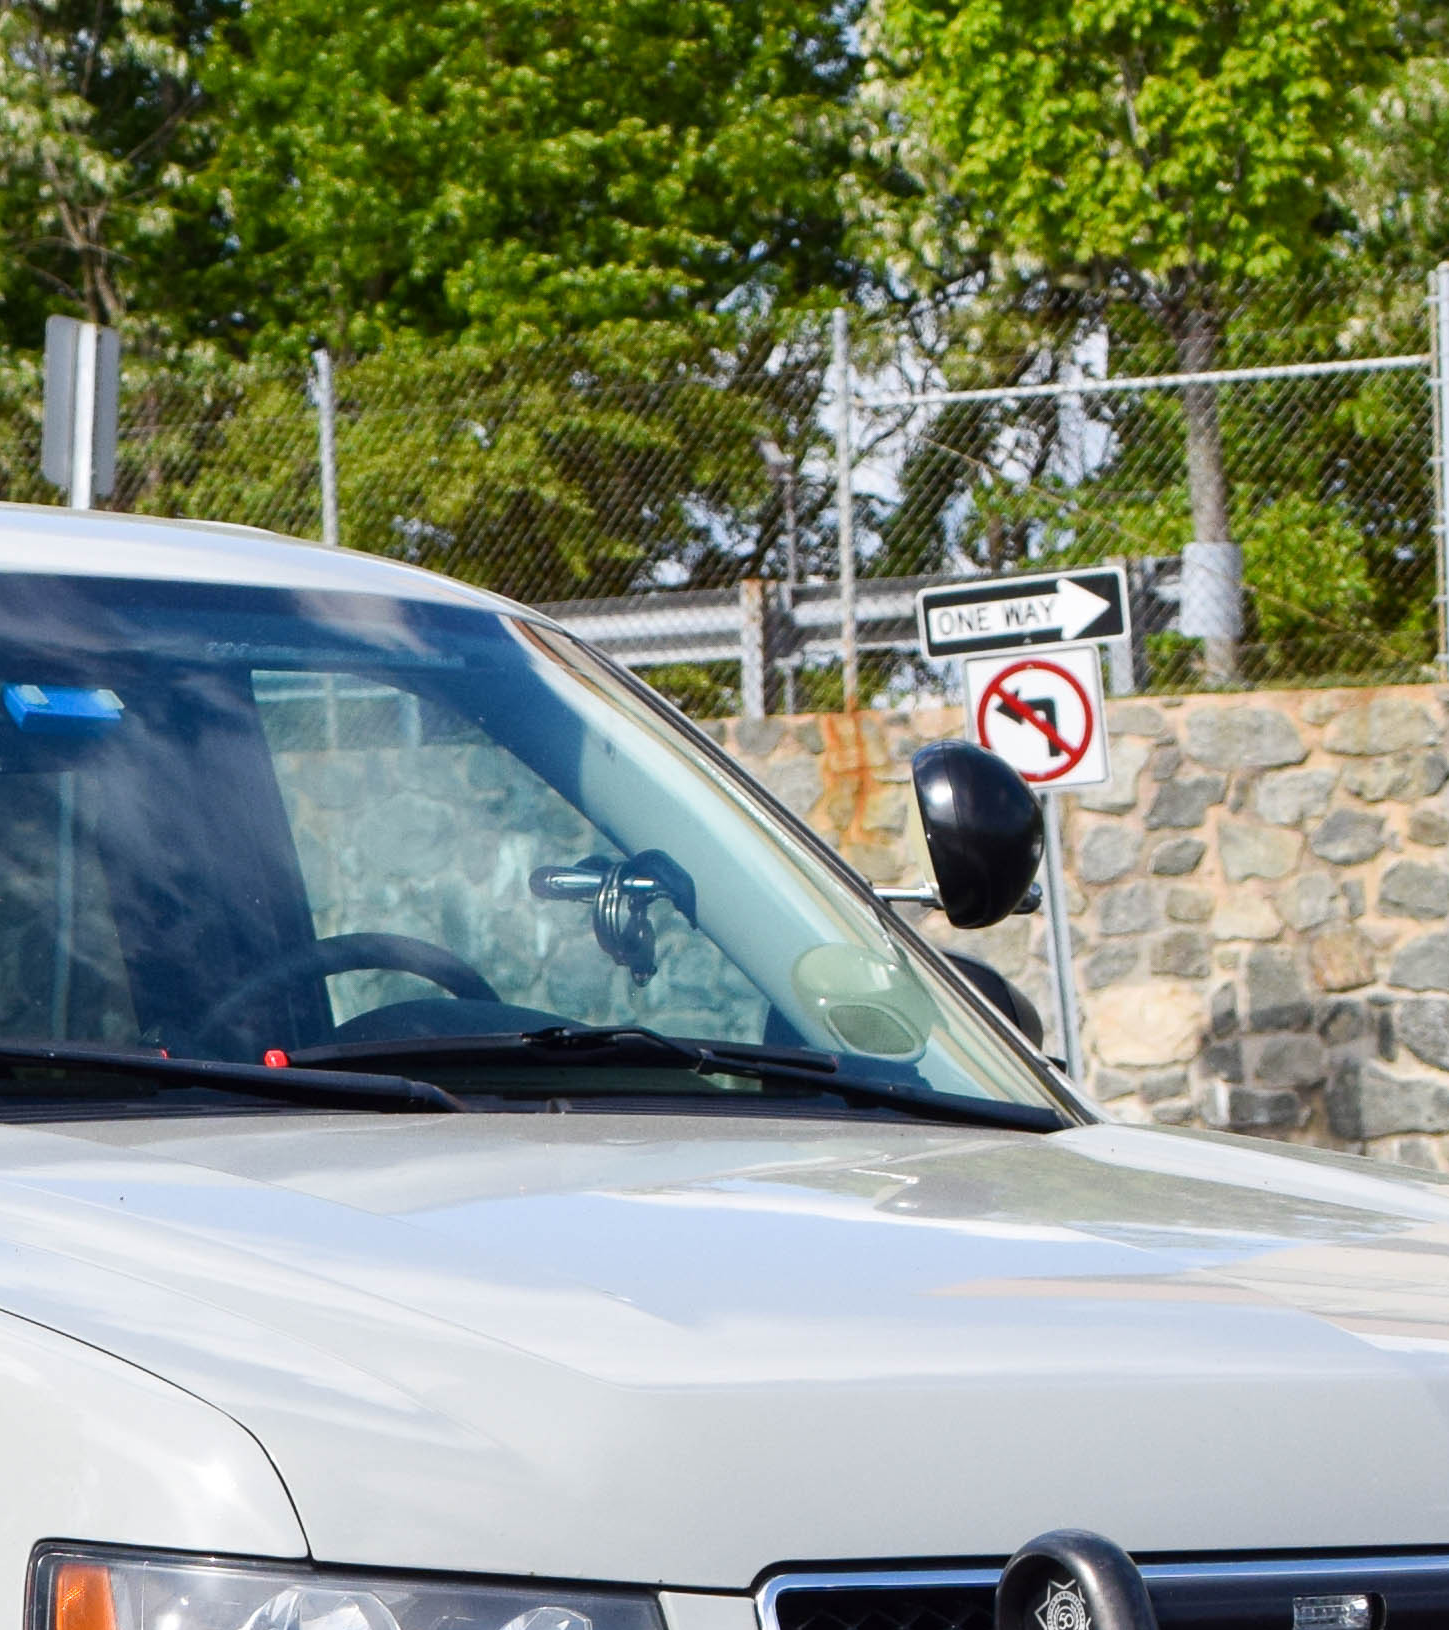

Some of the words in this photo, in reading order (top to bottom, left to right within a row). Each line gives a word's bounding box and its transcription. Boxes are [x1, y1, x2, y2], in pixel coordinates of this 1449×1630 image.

[938, 606, 992, 636] ONE
[1000, 597, 1057, 628] WAY
[1059, 1611, 1074, 1630] 50
